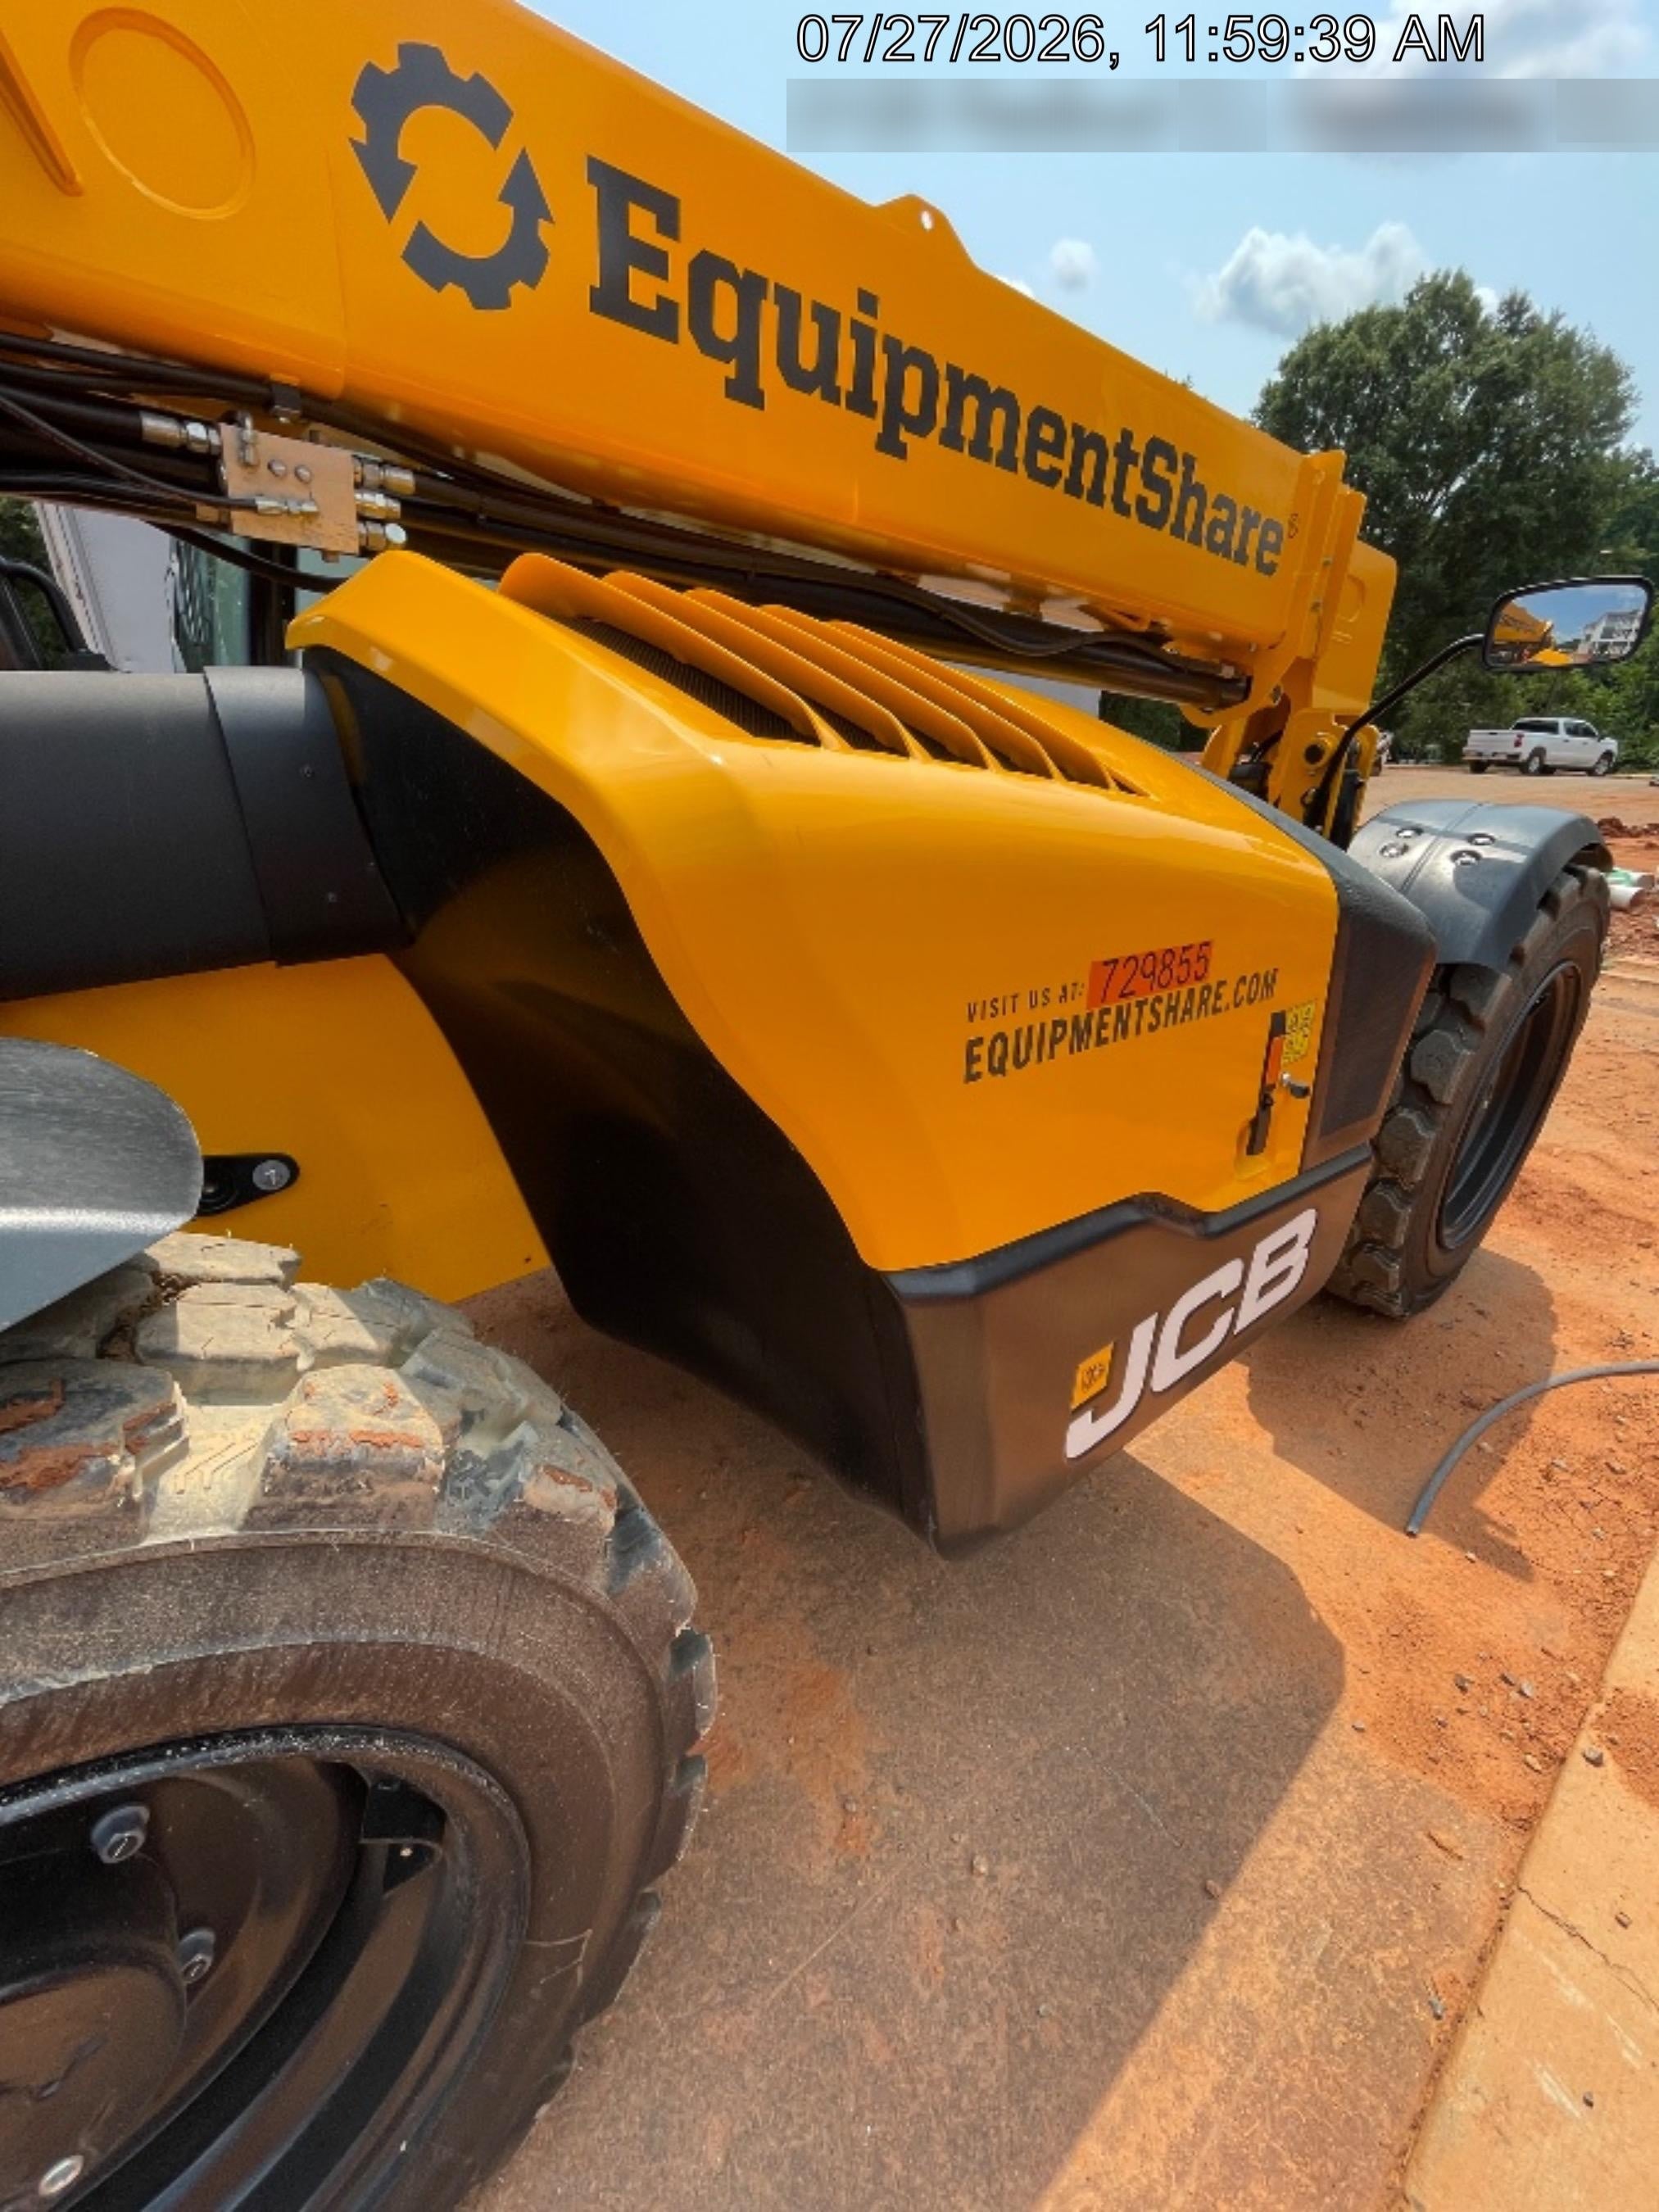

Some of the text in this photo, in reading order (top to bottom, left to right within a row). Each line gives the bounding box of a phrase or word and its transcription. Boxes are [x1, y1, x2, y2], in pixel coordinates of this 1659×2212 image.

[586, 153, 1284, 577] EquipmentShare
[963, 968, 1279, 1084] EQUIPMENTSHARE.COM
[968, 982, 1085, 1022] VISIT US AT:
[1101, 941, 1211, 1004] 729855
[1065, 1208, 1317, 1459] JCB
